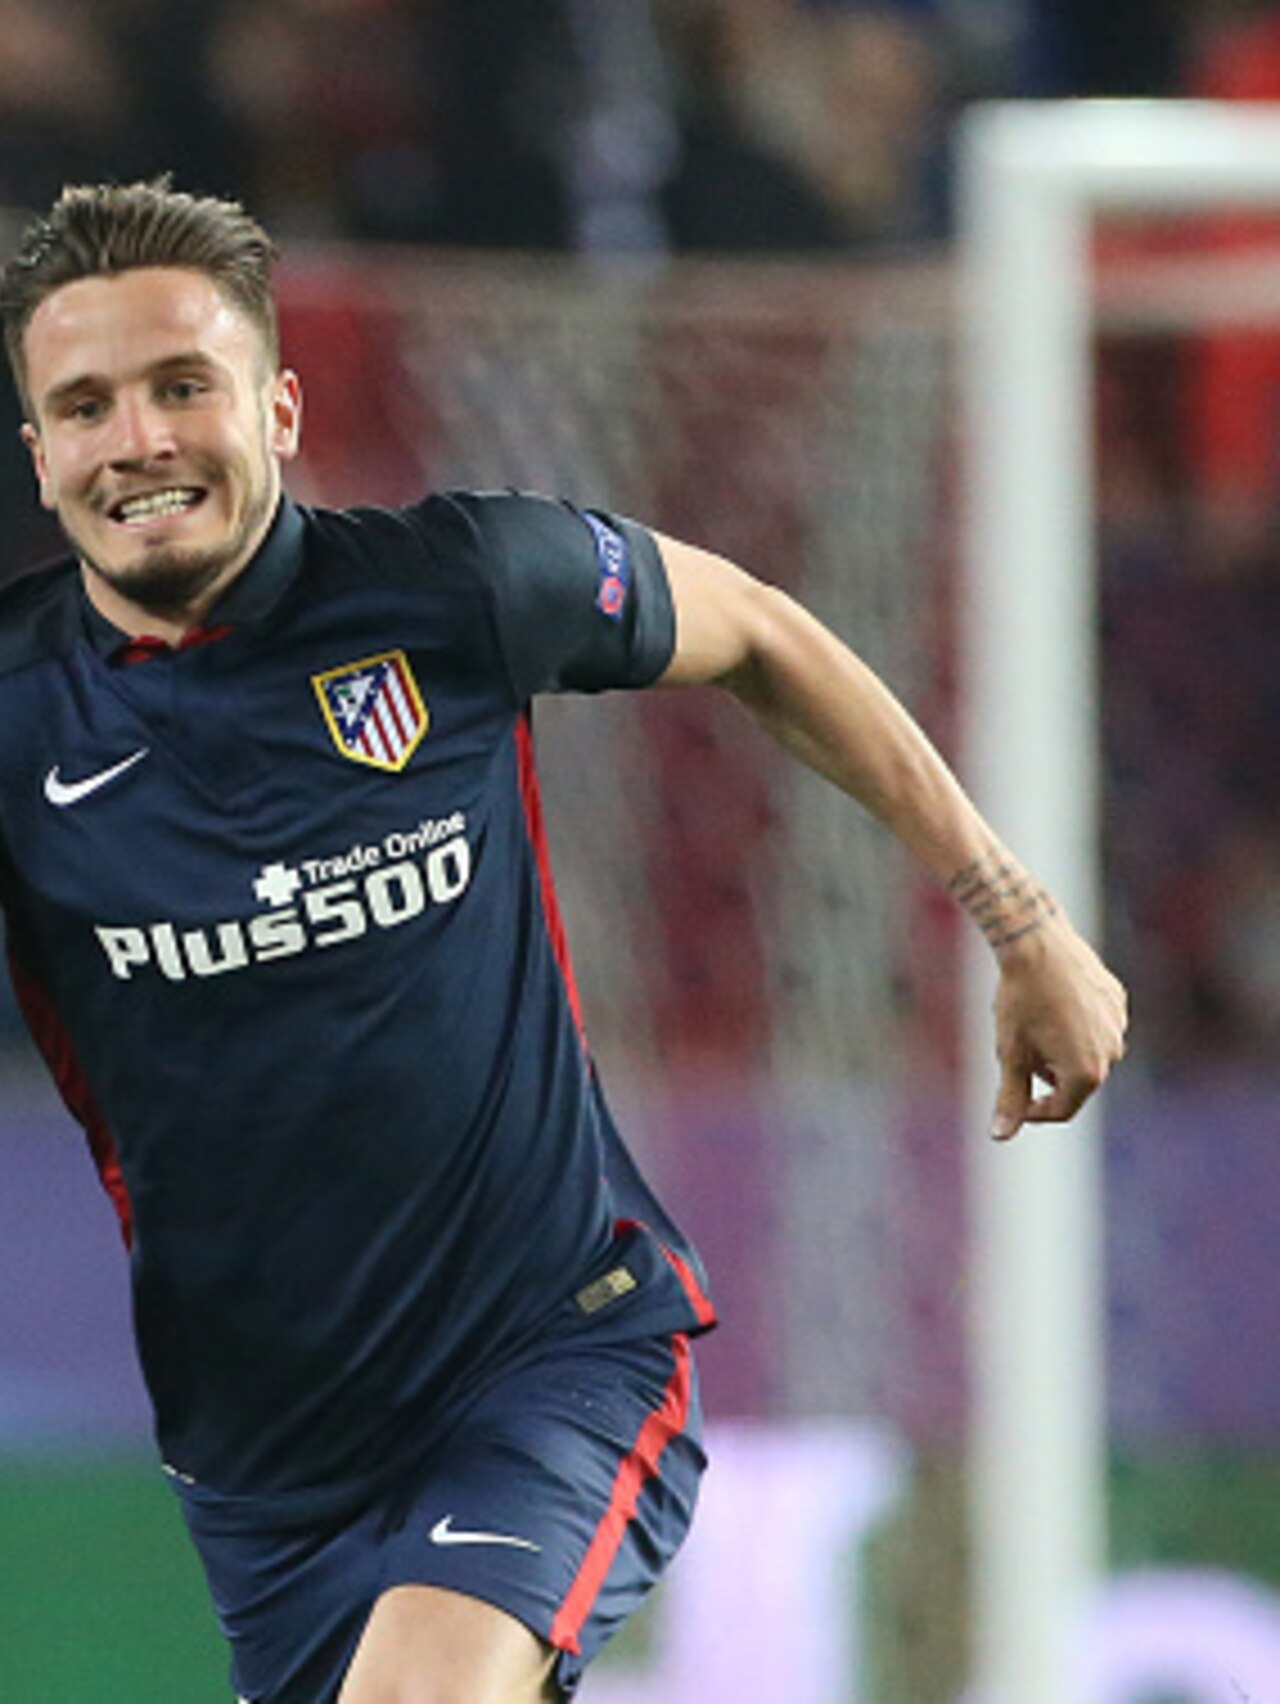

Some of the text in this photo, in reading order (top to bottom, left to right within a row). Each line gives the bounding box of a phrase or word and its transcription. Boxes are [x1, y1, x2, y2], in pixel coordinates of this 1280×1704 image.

[301, 811, 466, 885] Trade Online
[94, 836, 471, 980] Plus500
